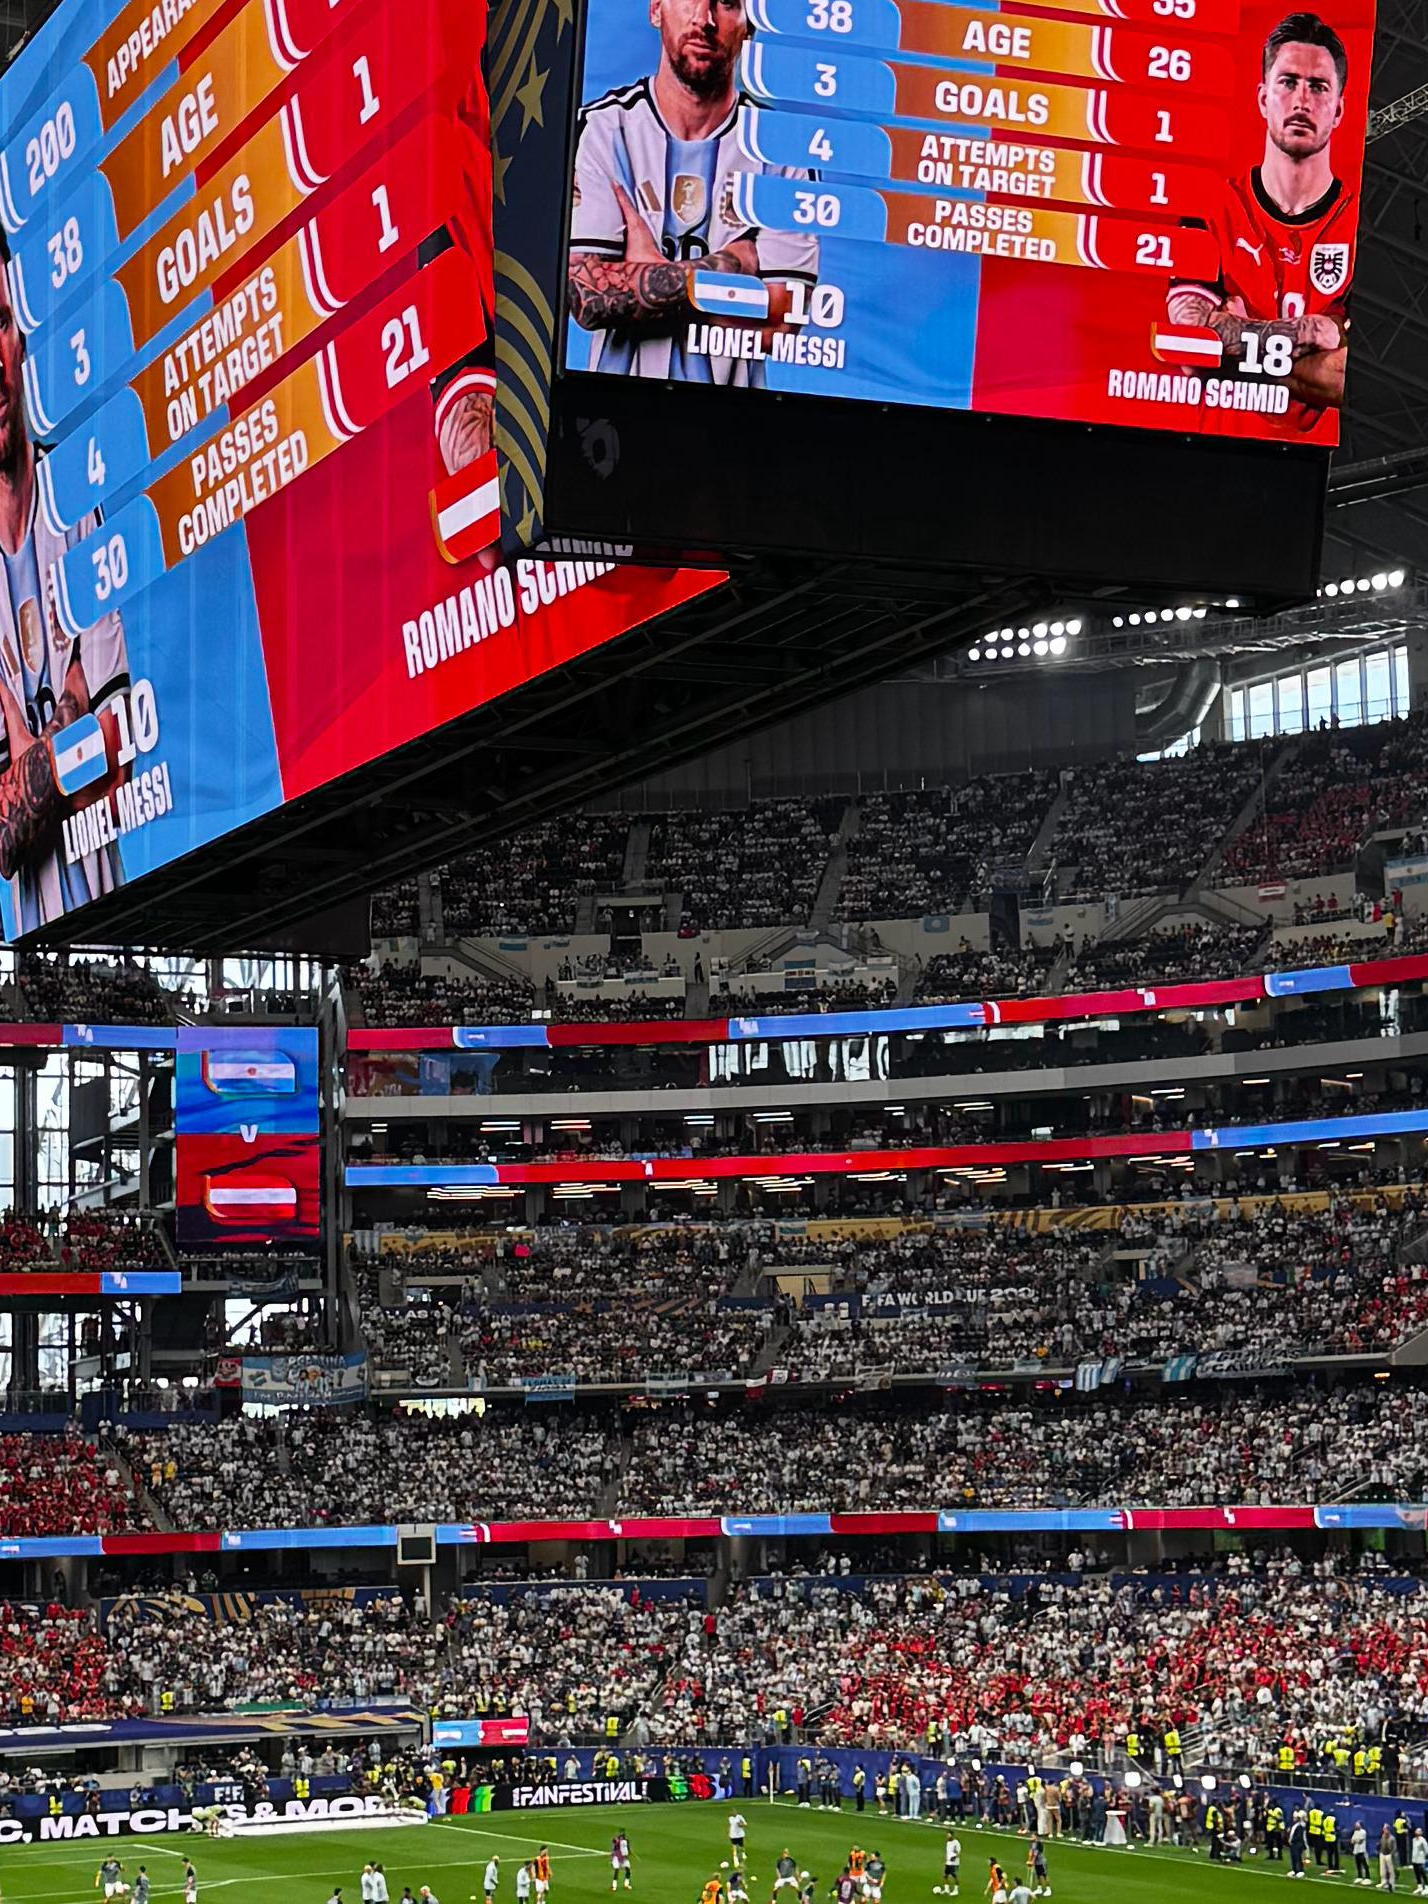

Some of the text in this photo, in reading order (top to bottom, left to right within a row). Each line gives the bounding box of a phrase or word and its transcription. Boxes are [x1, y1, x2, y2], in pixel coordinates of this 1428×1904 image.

[961, 21, 1032, 59] AGE
[1147, 46, 1192, 81] 26
[161, 72, 219, 178] AGE
[353, 55, 380, 125] 1
[814, 63, 1174, 143] 3 GOALS 1
[26, 100, 76, 192] 200
[808, 128, 1169, 205] 4 ATTEMPTS 1
[917, 159, 1056, 198] ON TARGET
[48, 216, 83, 288] 38
[156, 173, 254, 304] GOALS
[372, 185, 399, 253] 1
[793, 191, 1174, 267] 30 PASSES 21
[907, 222, 1057, 263] COMPLETED
[164, 267, 277, 398] ATTEMPTS
[783, 280, 845, 329] 10
[71, 328, 90, 386] 3
[167, 312, 285, 441] ON TARGET
[381, 304, 429, 389] 21
[687, 323, 846, 369] LIONEL MESSI
[1238, 331, 1293, 377] 18
[1107, 369, 1290, 415] ROMANO SCHMID
[87, 436, 105, 486] 4
[191, 399, 278, 497] PASSES
[178, 429, 308, 556] COMPLETED
[92, 534, 128, 600] 30
[402, 566, 515, 679] ROMANO
[111, 679, 160, 767] 10
[62, 761, 173, 865] LIONEL MESSI
[862, 1292, 897, 1307] FFA
